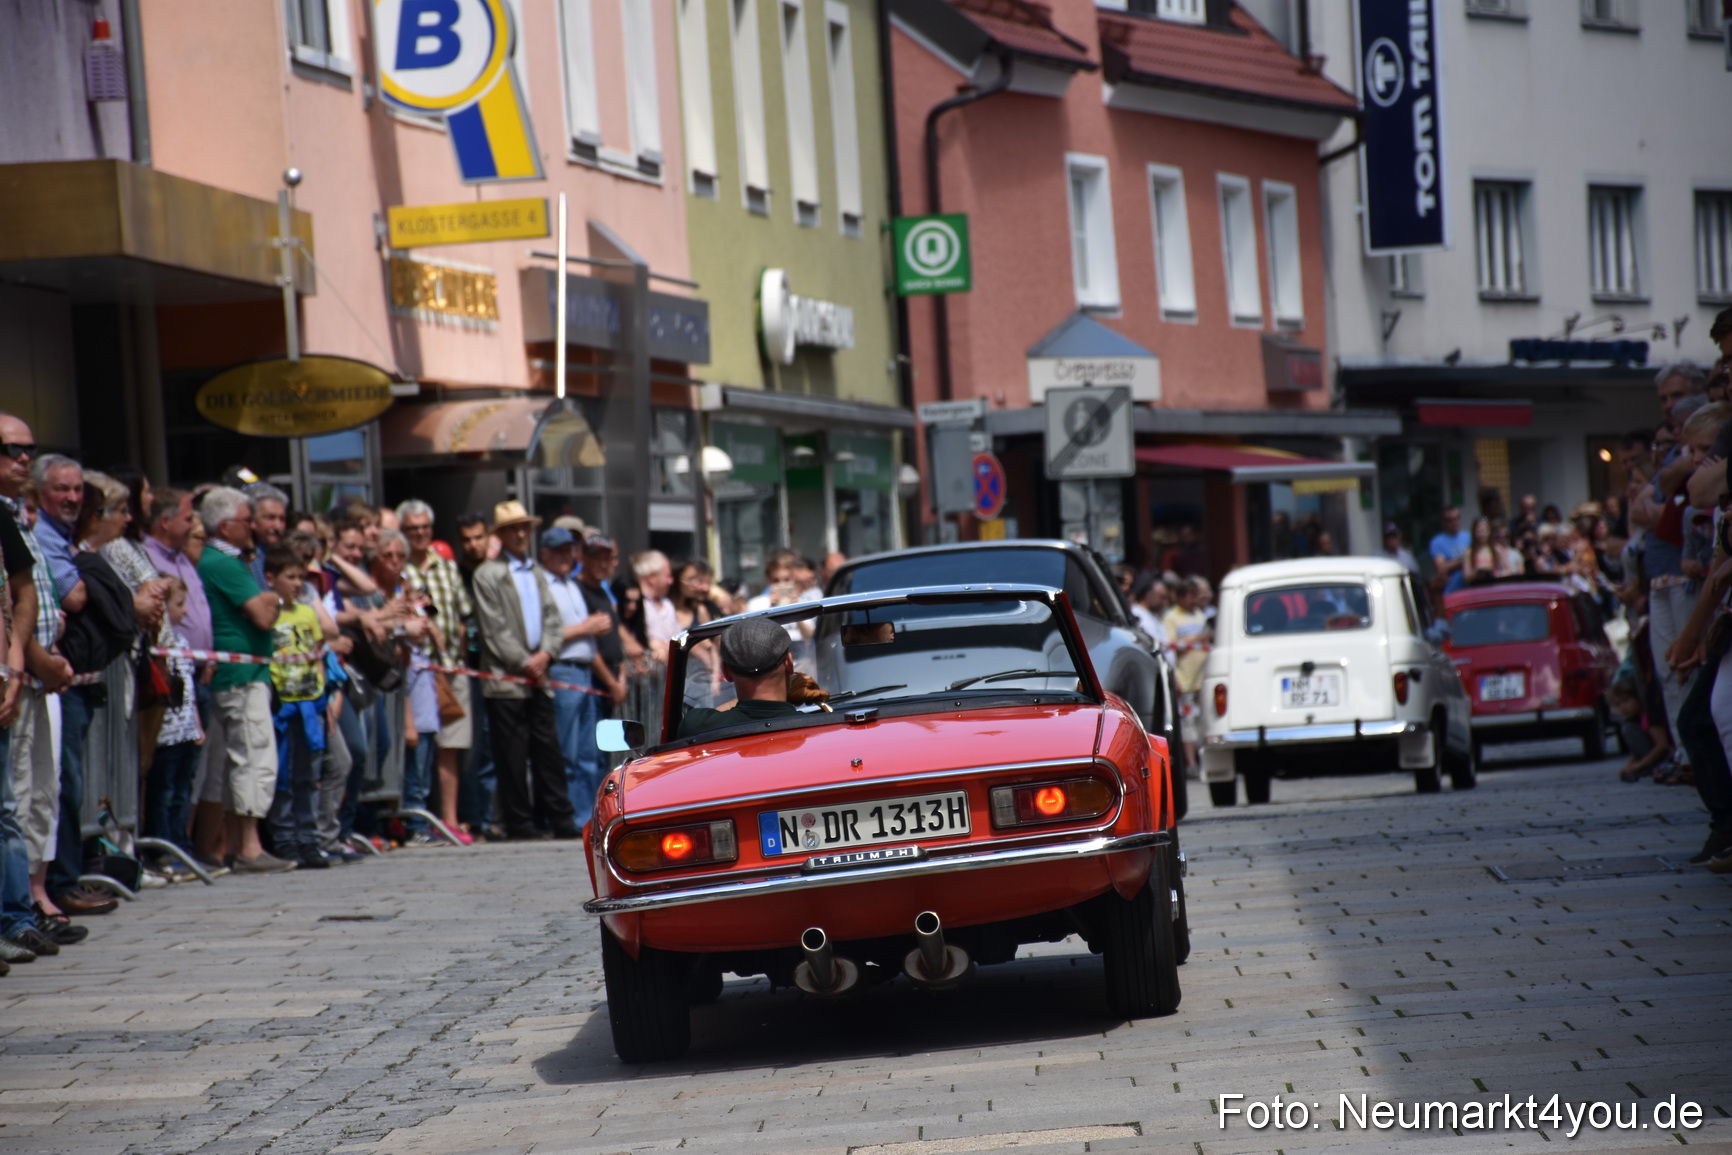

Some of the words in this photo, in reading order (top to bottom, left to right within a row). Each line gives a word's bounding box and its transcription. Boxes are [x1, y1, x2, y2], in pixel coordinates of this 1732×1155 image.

[394, 0, 462, 71] B
[1412, 95, 1436, 218] TOM
[396, 208, 521, 235] KLOSTERGASSE
[527, 208, 537, 224] 4
[205, 393, 234, 409] DIE
[1313, 690, 1330, 705] 71
[780, 815, 800, 849] N
[822, 809, 861, 844] DR
[869, 796, 967, 839] 1313H
[767, 838, 776, 848] D
[819, 849, 908, 865] TRIUMPH
